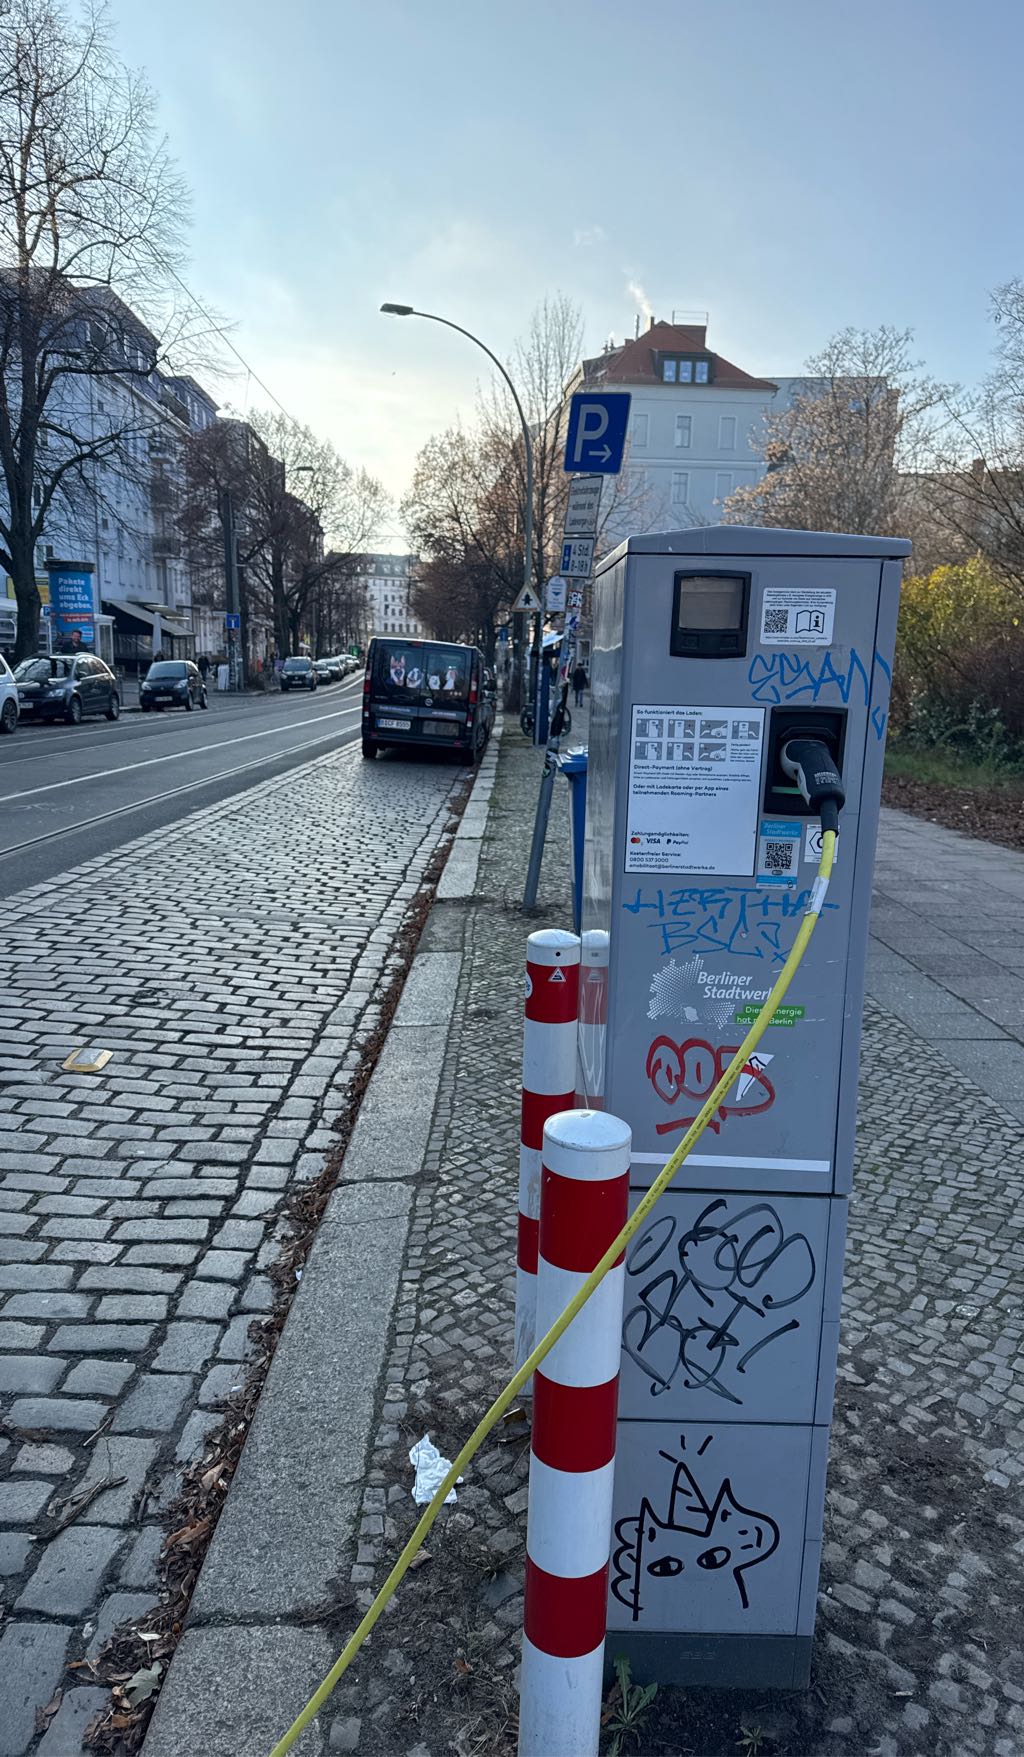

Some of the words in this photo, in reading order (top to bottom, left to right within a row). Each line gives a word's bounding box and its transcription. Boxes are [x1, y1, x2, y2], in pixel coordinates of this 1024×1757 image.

[573, 403, 609, 462] P
[578, 544, 590, 556] Std.
[58, 577, 85, 586] Pakete
[59, 585, 82, 594] direkt
[59, 601, 92, 609] abgeben.
[697, 971, 753, 986] Berliner
[776, 1007, 802, 1017] nergie
